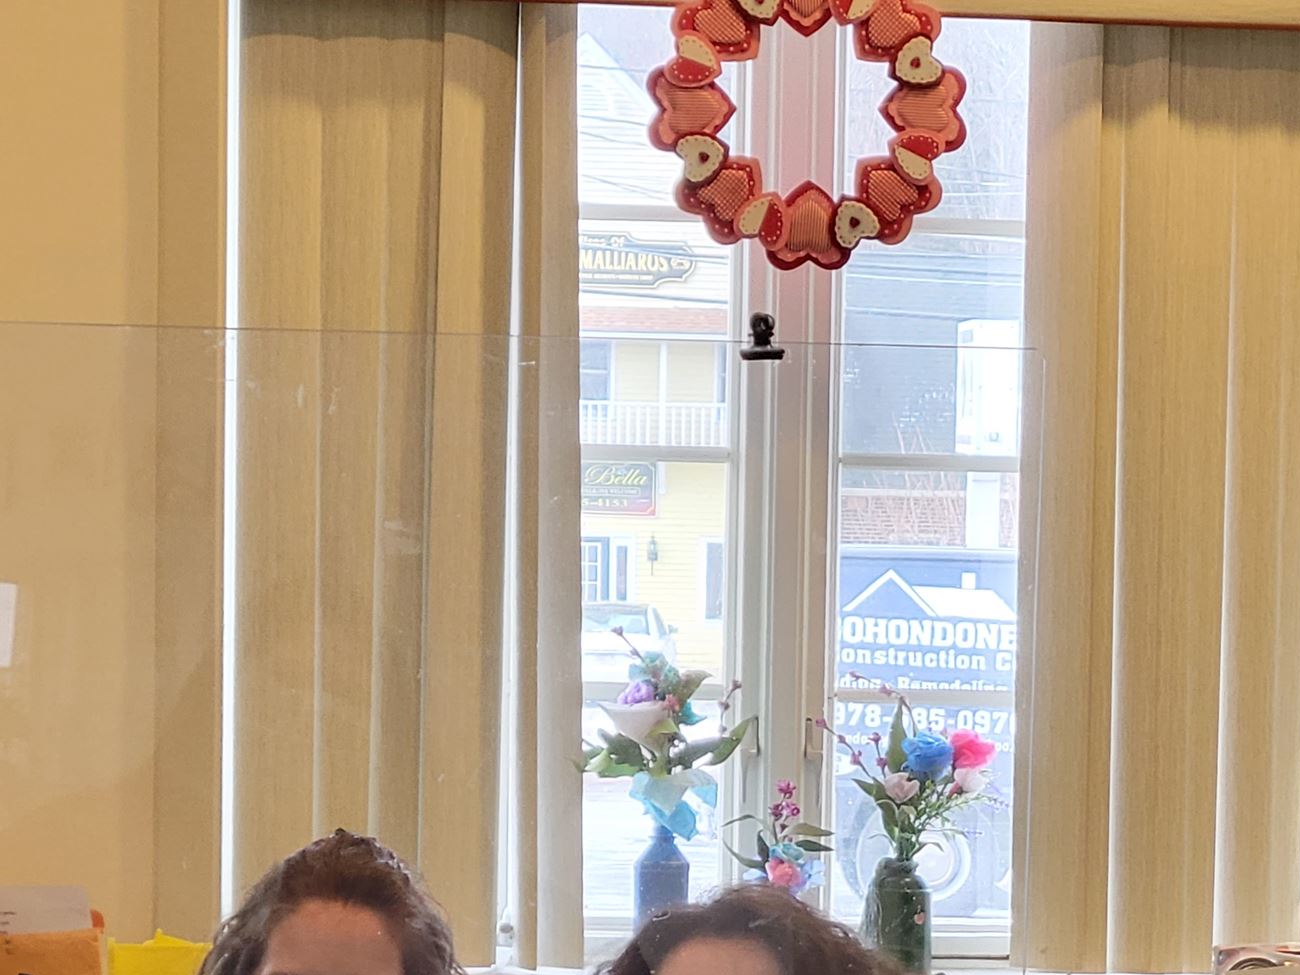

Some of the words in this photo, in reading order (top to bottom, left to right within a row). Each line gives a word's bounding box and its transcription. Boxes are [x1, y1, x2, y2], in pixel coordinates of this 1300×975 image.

[838, 647, 987, 671] onstruction
[995, 651, 1017, 671] C
[835, 702, 1017, 733] 978-85-097
